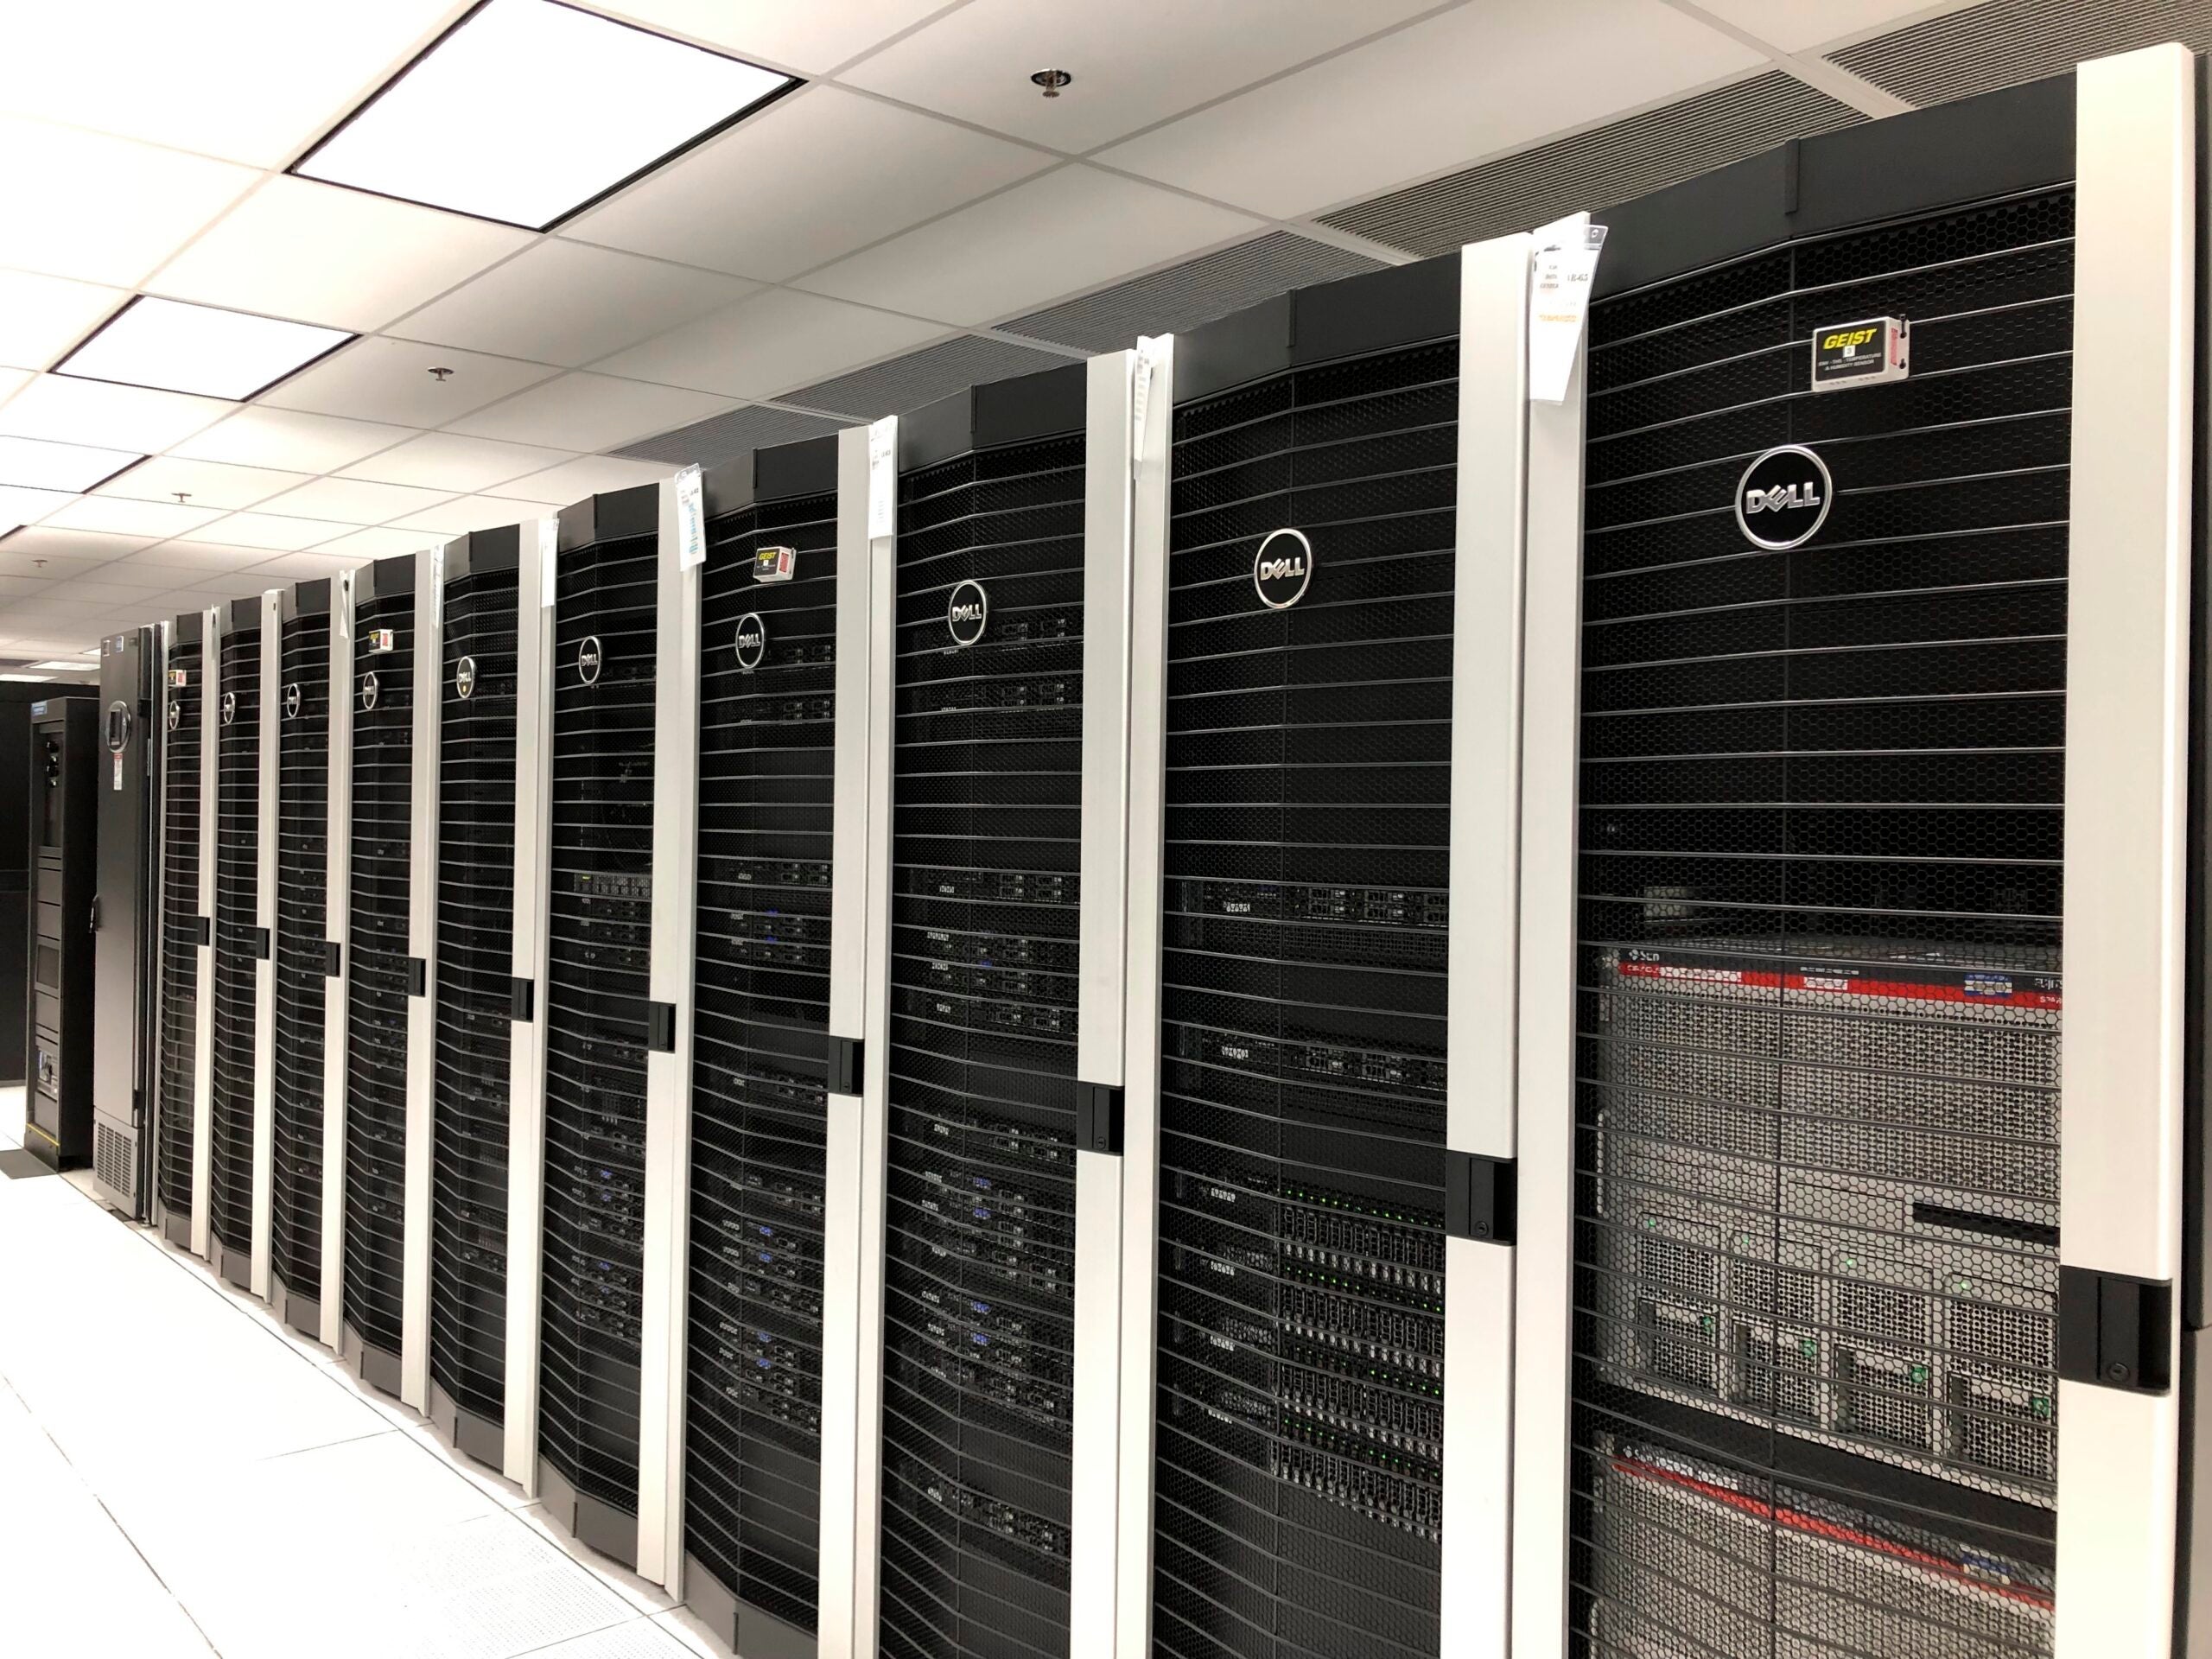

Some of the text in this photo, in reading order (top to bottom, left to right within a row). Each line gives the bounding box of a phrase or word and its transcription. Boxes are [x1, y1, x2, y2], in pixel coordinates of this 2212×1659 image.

[1823, 328, 1878, 349] GEIST
[1746, 481, 1820, 514] DELL
[759, 551, 777, 561] GEIST
[1261, 557, 1305, 581] DELL
[952, 604, 982, 622] DELL
[738, 632, 761, 648] DELL
[581, 652, 598, 667] DELL
